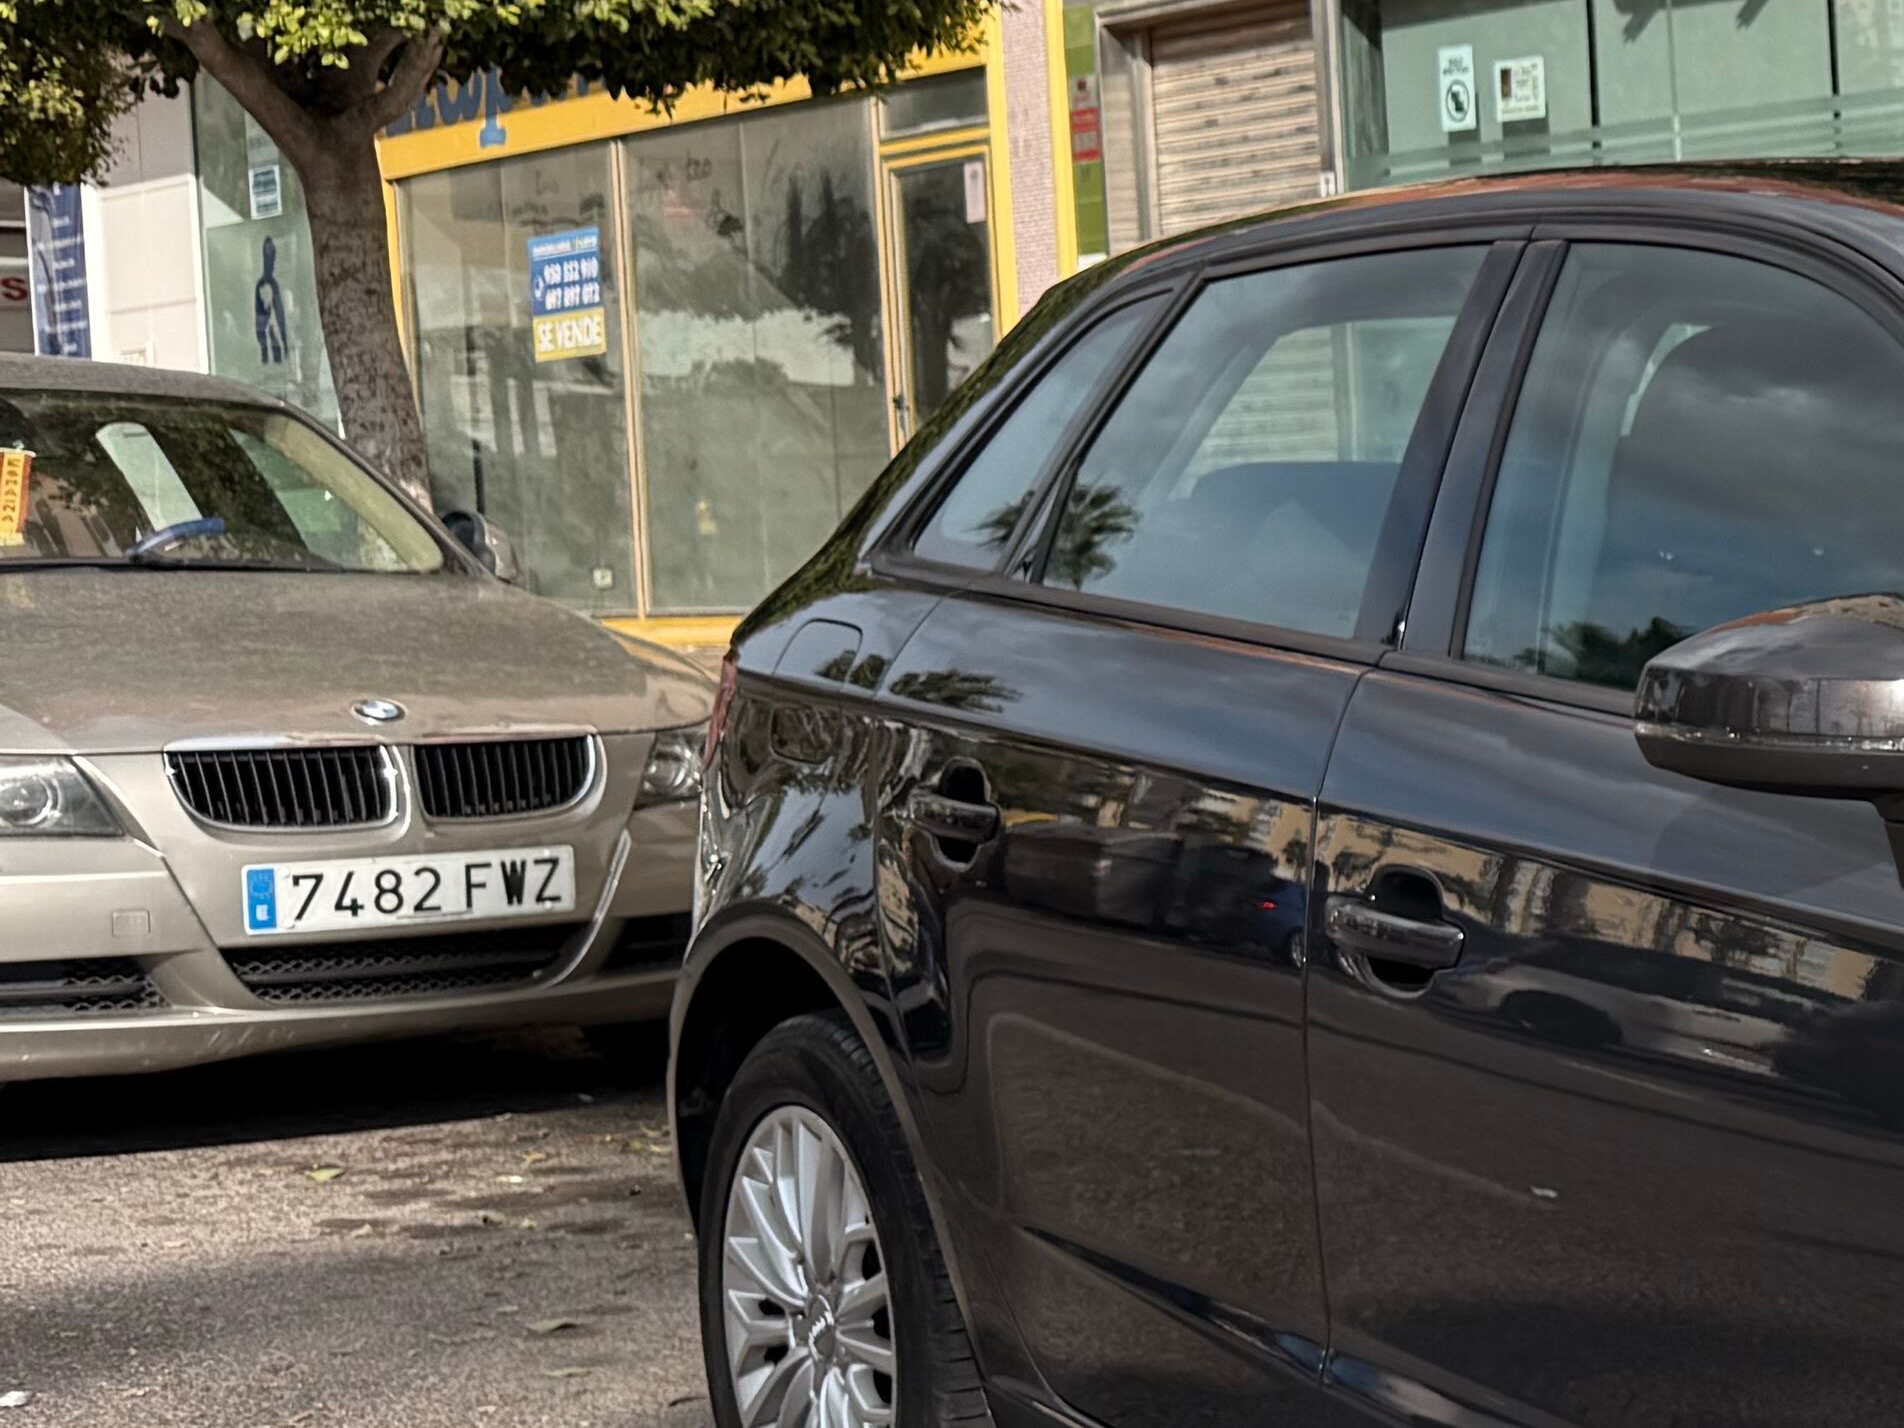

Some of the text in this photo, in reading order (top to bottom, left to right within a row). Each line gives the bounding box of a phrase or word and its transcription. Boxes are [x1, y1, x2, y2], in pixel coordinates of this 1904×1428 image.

[537, 314, 602, 352] SE VENDE
[290, 856, 565, 924] 7482 FWZ
